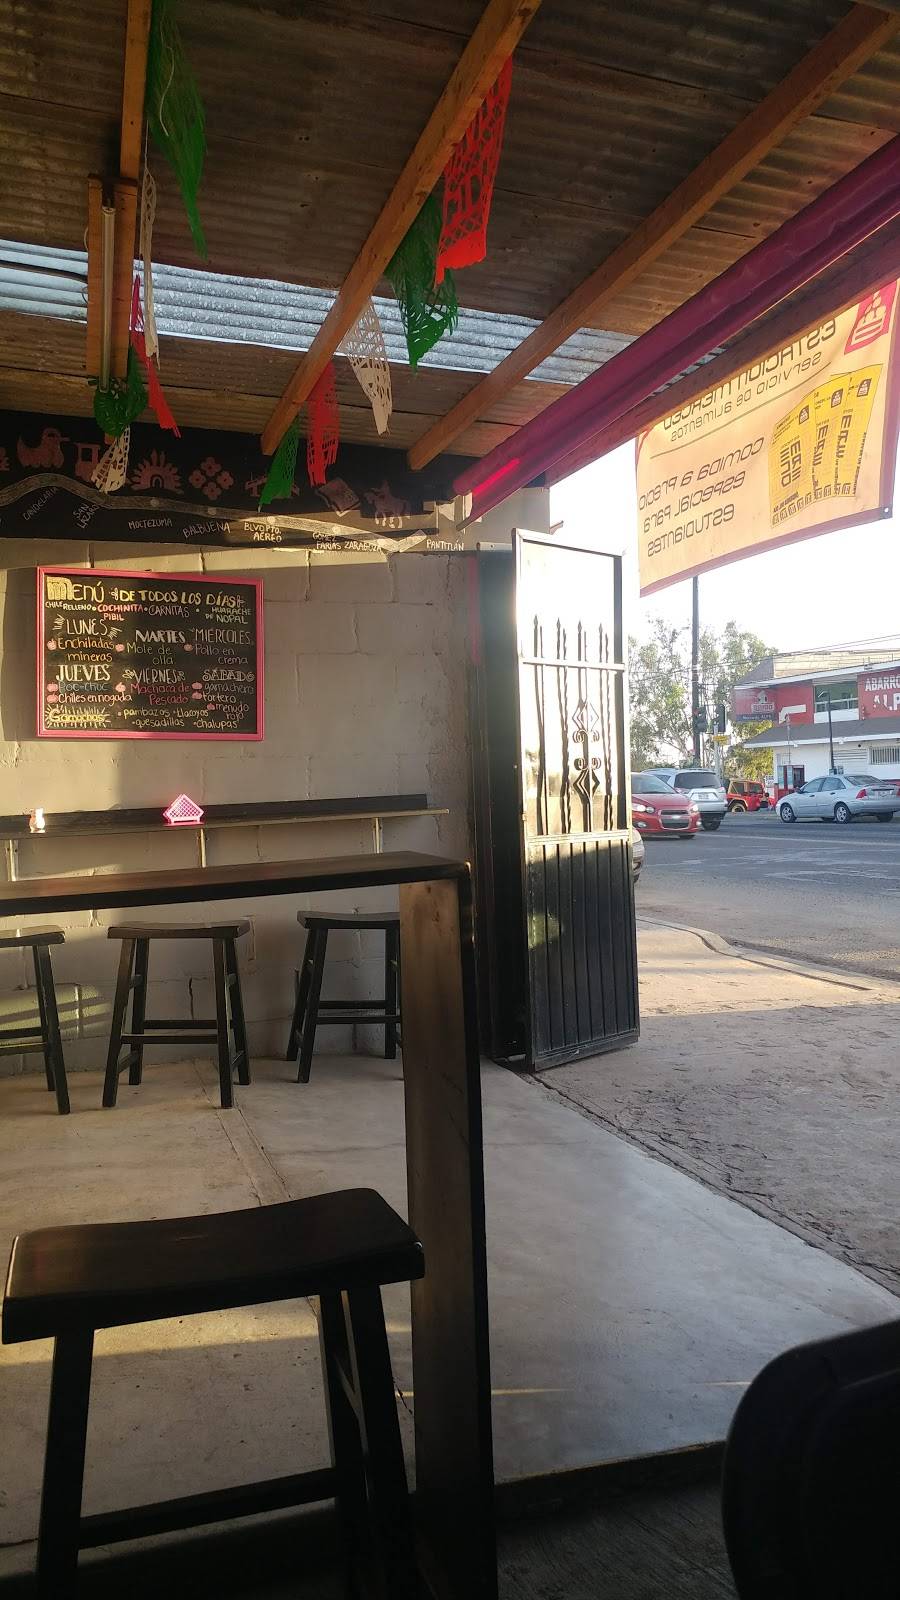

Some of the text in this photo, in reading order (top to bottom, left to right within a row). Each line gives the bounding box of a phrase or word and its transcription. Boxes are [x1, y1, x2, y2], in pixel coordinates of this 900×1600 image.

[72, 503, 90, 519] SAN
[127, 518, 173, 530] MOCTEZUMA
[182, 521, 231, 538] BALBUENA
[426, 538, 464, 551] PANTITLÁN
[119, 591, 135, 601] DE
[139, 590, 178, 602] TODOS
[181, 592, 202, 605] LOS
[206, 591, 236, 608] DÍAS
[45, 601, 252, 618] CHILE RELLENO COCHINITA CARNITAS HUARACHE
[103, 612, 125, 621] PIBIL
[216, 614, 248, 624] NOPAL
[66, 618, 108, 636] LUNES
[135, 629, 186, 643] MARTES
[57, 637, 235, 656] Enchiladas Mole de Pollo en
[67, 651, 248, 665] mineras olla crema
[56, 664, 111, 682] JUEVES
[133, 668, 177, 684] VIERNES
[179, 683, 190, 693] de
[58, 692, 87, 703] Chiles
[87, 694, 97, 702] en
[98, 692, 133, 706] nogada
[149, 694, 190, 706] Pescado
[123, 706, 171, 719] pambazos
[215, 701, 250, 713] menudo
[135, 717, 238, 730] quesadillas chalupas
